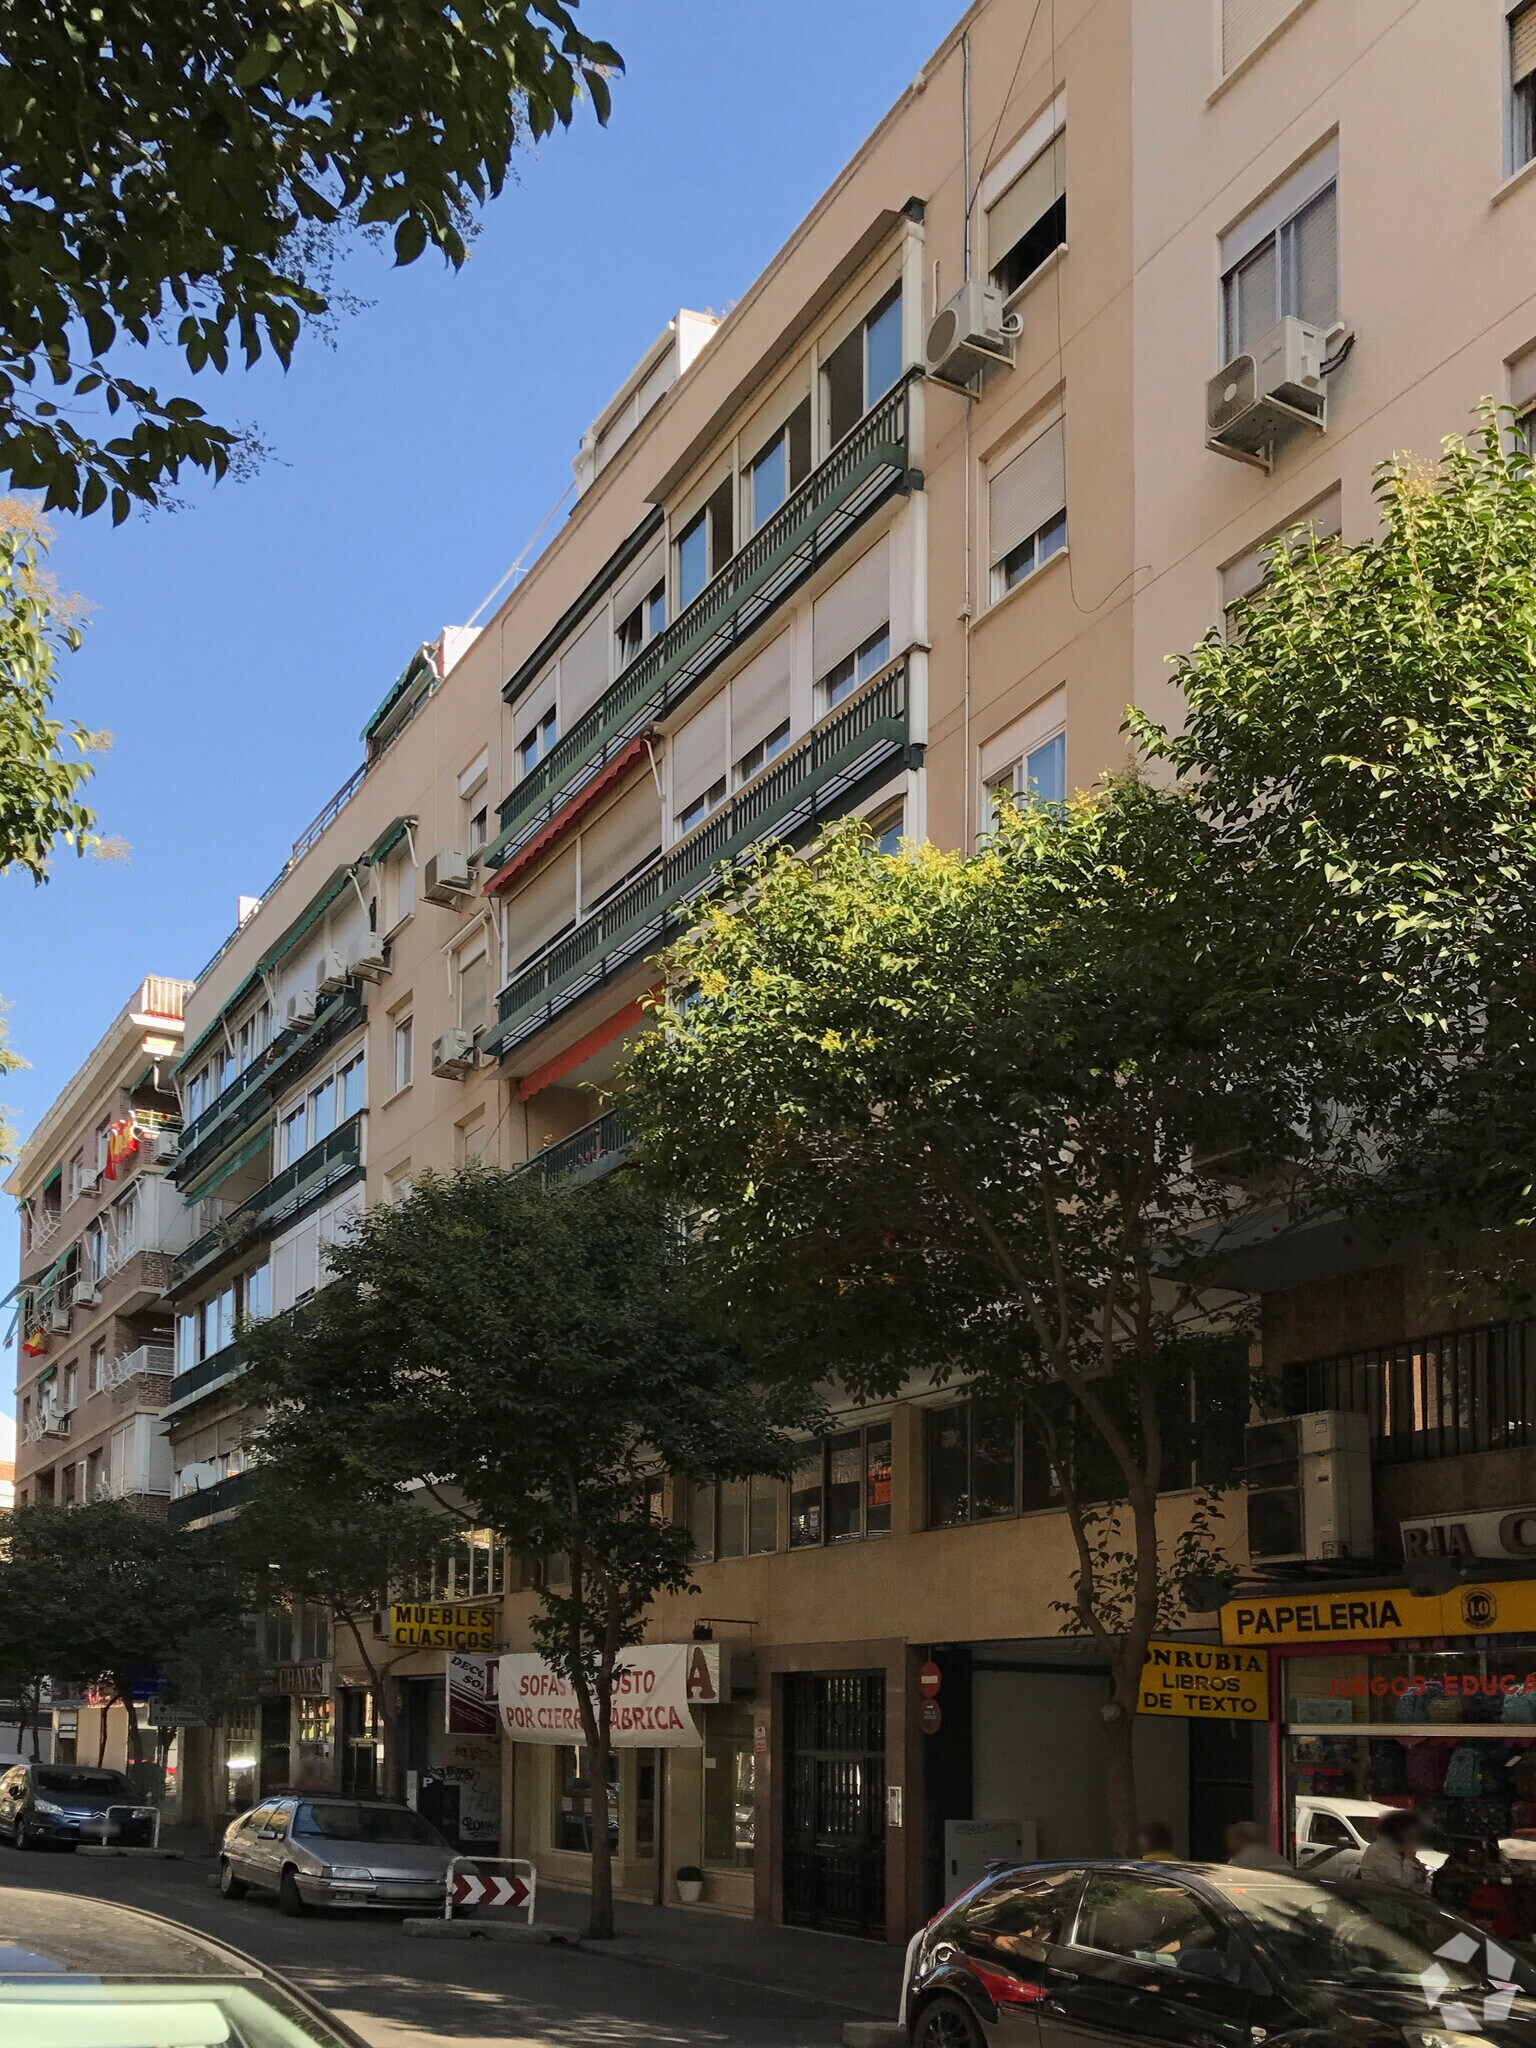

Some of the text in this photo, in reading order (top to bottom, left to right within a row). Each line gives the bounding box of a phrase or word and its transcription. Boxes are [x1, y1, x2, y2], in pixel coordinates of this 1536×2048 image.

[396, 1606, 492, 1628] MUEBLES
[1237, 1600, 1402, 1635] PAPELERIA
[396, 1628, 492, 1649] CLASICOS
[279, 1666, 322, 1693] CHAVES
[520, 1674, 567, 1697] SOFAS
[1162, 1673, 1241, 1692] LIBROS
[1325, 1674, 1428, 1697] JUEGOS
[1144, 1692, 1257, 1713] DE TEXTO
[506, 1707, 535, 1728] POR
[538, 1707, 583, 1729] CIERR
[610, 1700, 685, 1730] ÁBRICA
